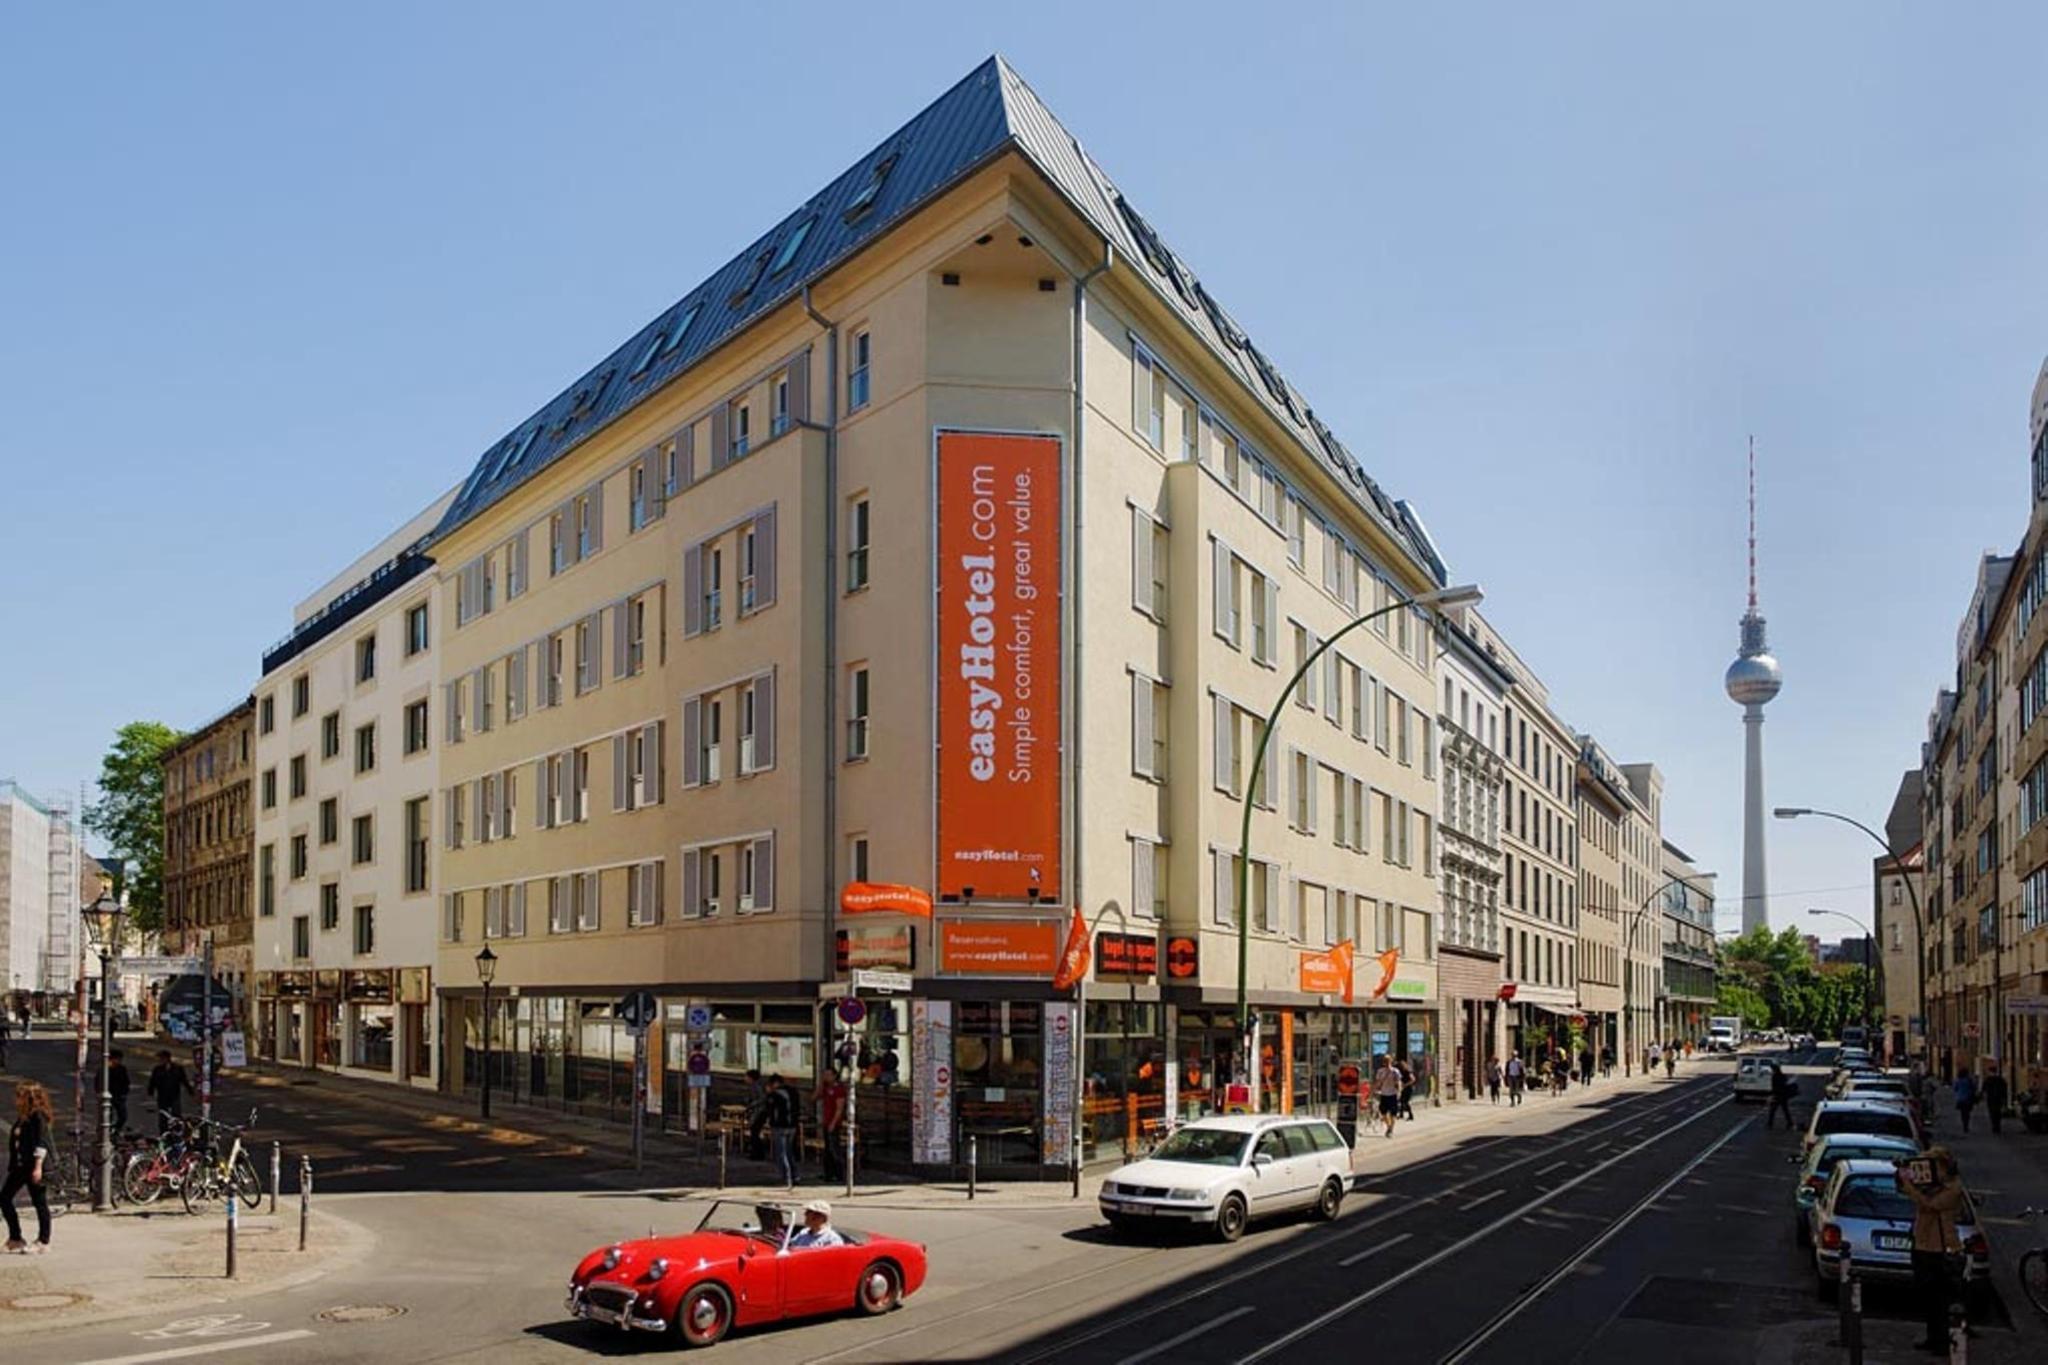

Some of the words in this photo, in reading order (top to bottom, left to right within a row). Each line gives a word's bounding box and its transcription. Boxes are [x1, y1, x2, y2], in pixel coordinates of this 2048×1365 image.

[1007, 467, 1032, 533] value.
[1012, 541, 1037, 600] great
[961, 464, 1002, 782] easyHotel.com
[1006, 609, 1035, 700] comfort,
[1007, 707, 1037, 783] Simple
